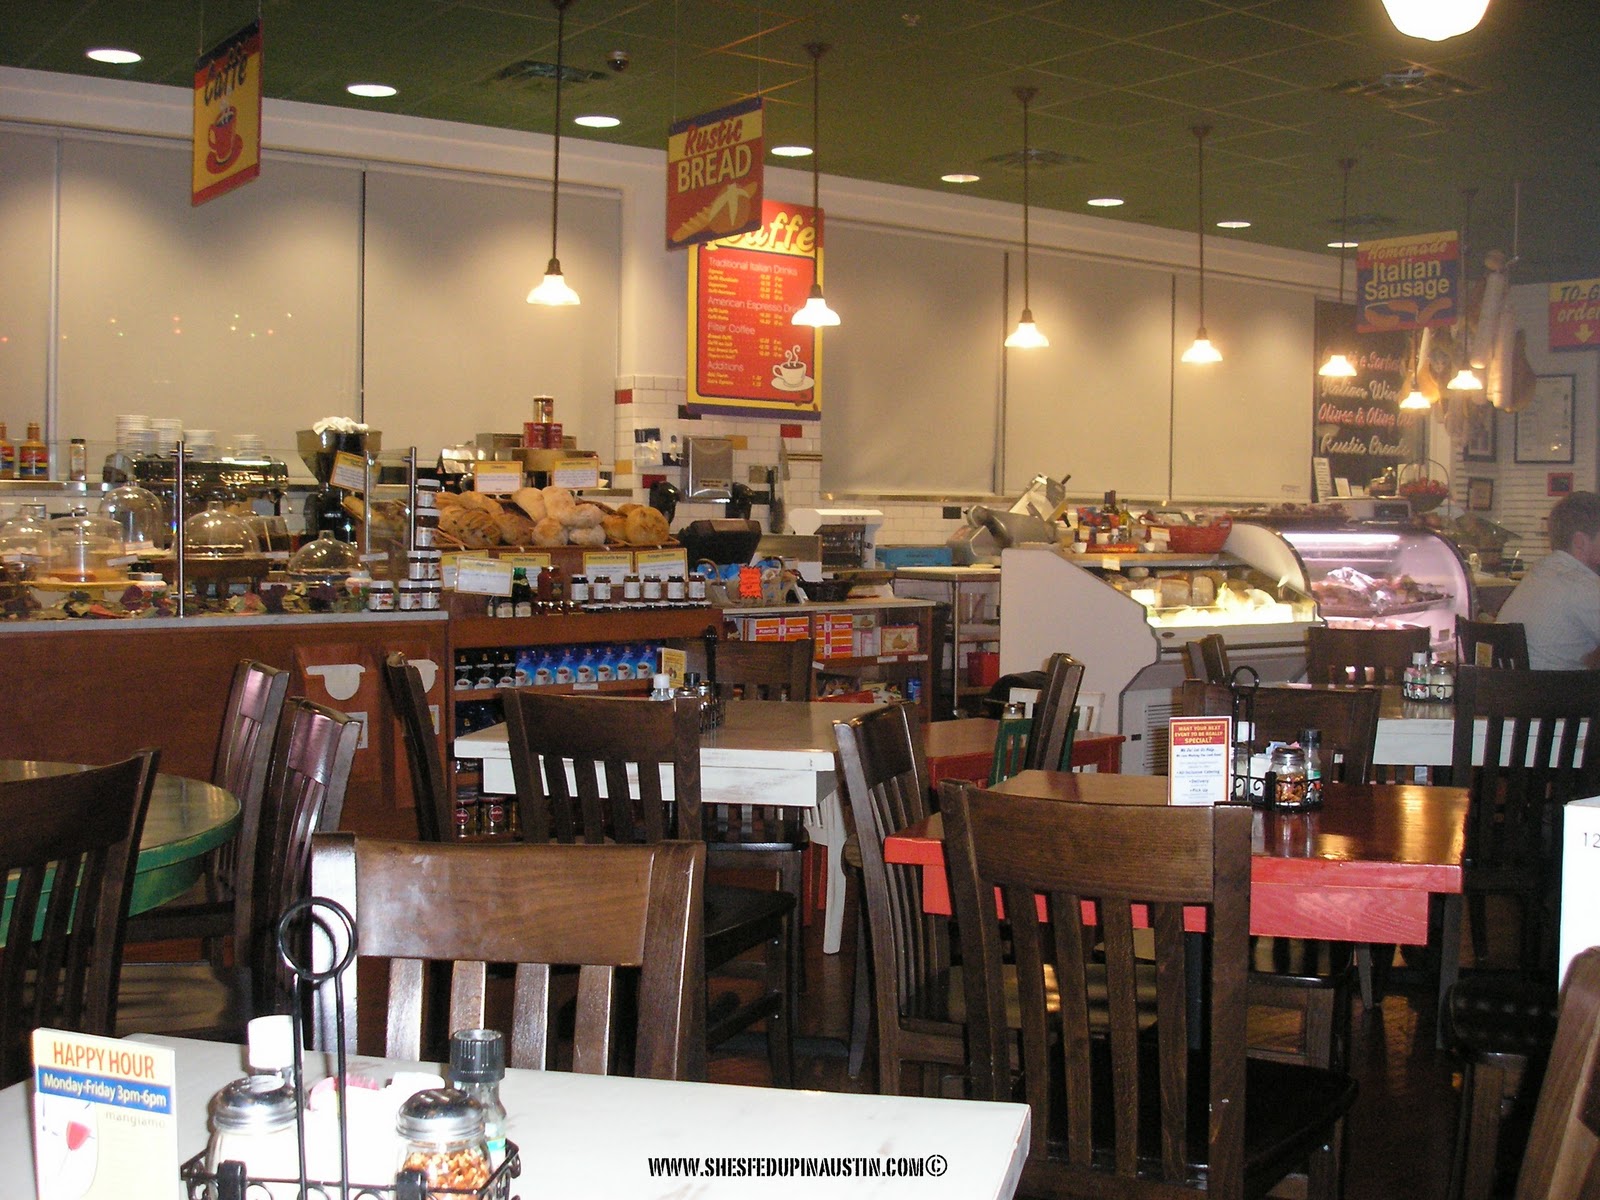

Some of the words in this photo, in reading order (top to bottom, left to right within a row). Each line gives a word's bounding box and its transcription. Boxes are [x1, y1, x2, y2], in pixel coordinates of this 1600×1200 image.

[684, 117, 744, 158] Rustic
[677, 145, 752, 193] BREAD
[1368, 238, 1448, 260] Homemade
[708, 256, 748, 271] Traditional
[749, 262, 772, 273] Italian
[773, 264, 798, 276] Drinks
[1373, 259, 1441, 287] Italian
[1364, 277, 1450, 301] Sausage
[708, 296, 745, 308] American
[746, 300, 782, 312] Espresso
[728, 323, 756, 335] Coffee
[707, 360, 744, 373] Additions
[53, 1041, 105, 1071] HAPPY
[109, 1049, 155, 1079] HOUR
[43, 1072, 116, 1103] Monday-Friday
[117, 1084, 167, 1107] 3pm-6pm
